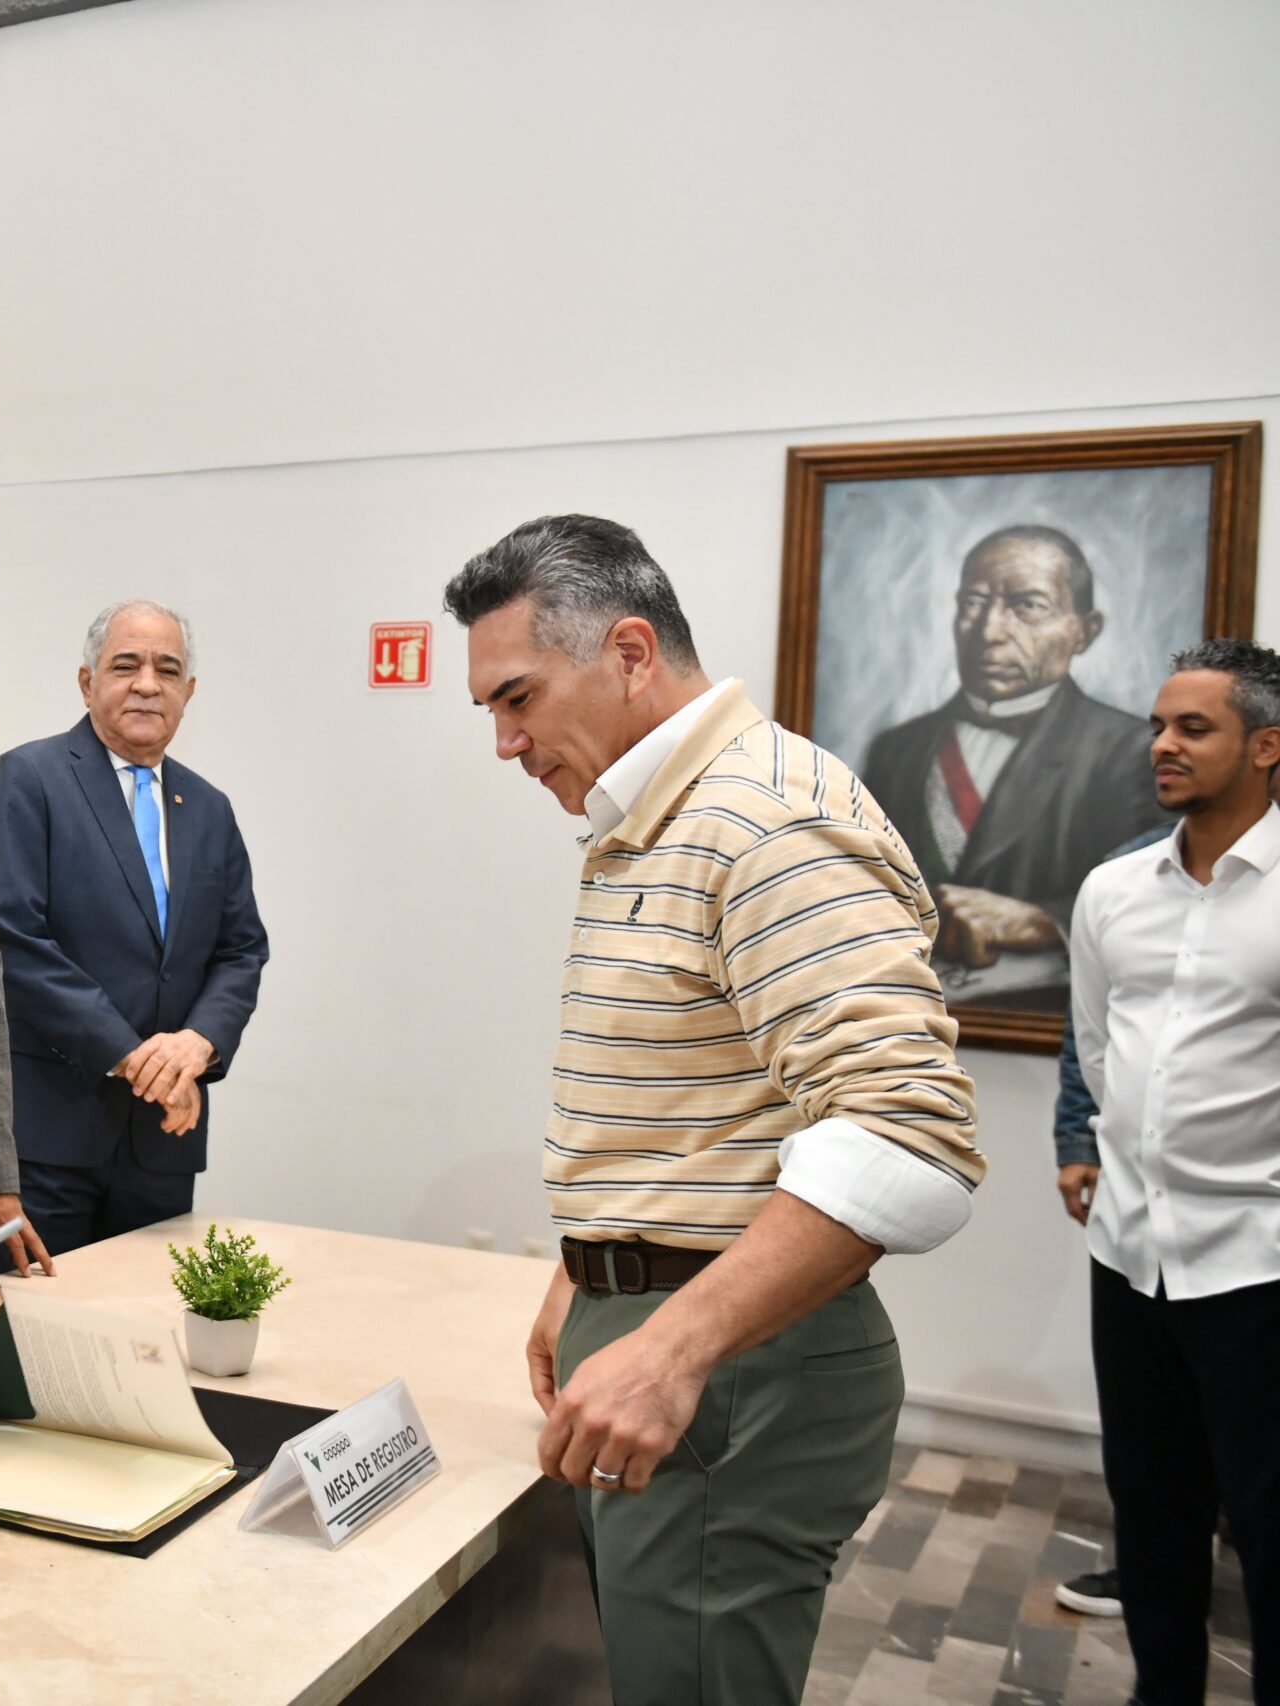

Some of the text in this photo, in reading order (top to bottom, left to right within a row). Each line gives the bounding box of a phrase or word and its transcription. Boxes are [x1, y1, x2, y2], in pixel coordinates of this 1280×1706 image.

[323, 1469, 359, 1508] MESA
[355, 1457, 374, 1484] DE
[370, 1425, 418, 1472] REGISTRO
